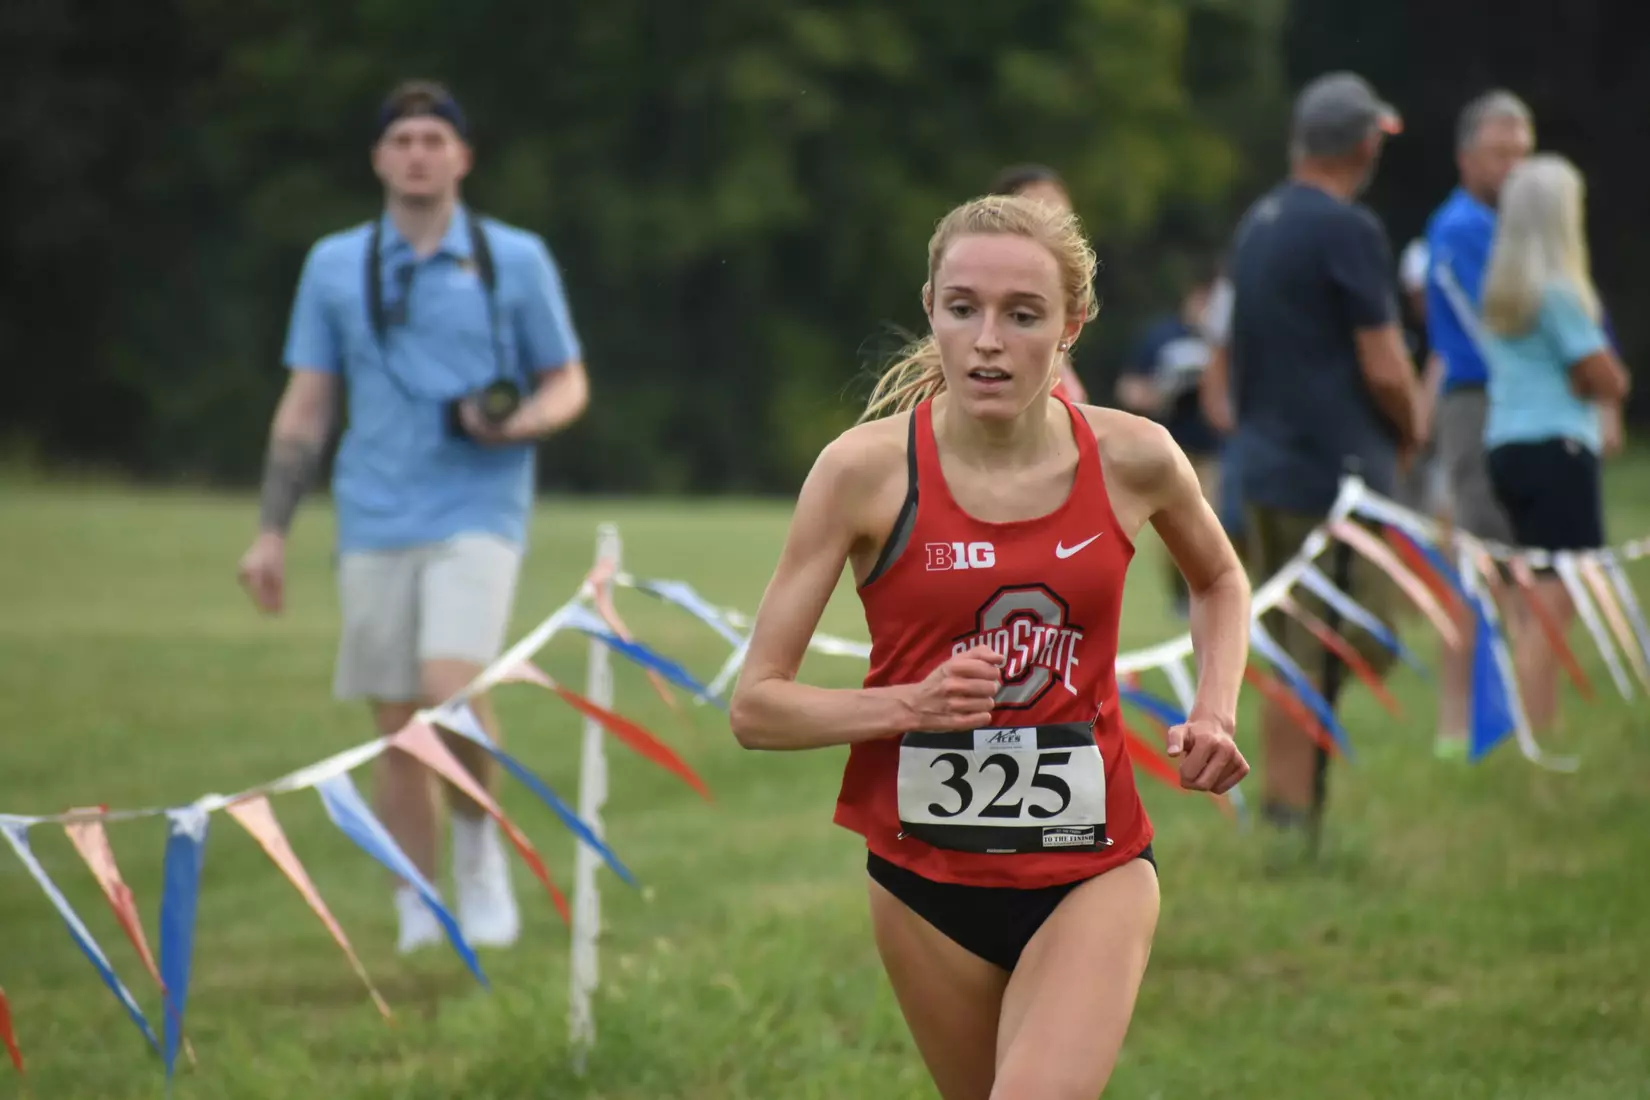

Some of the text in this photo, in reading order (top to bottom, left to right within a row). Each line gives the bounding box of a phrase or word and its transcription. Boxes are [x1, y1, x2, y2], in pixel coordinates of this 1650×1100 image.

[1008, 619, 1084, 696] STATE
[927, 752, 1072, 819] 325
[1043, 835, 1053, 843] TO
